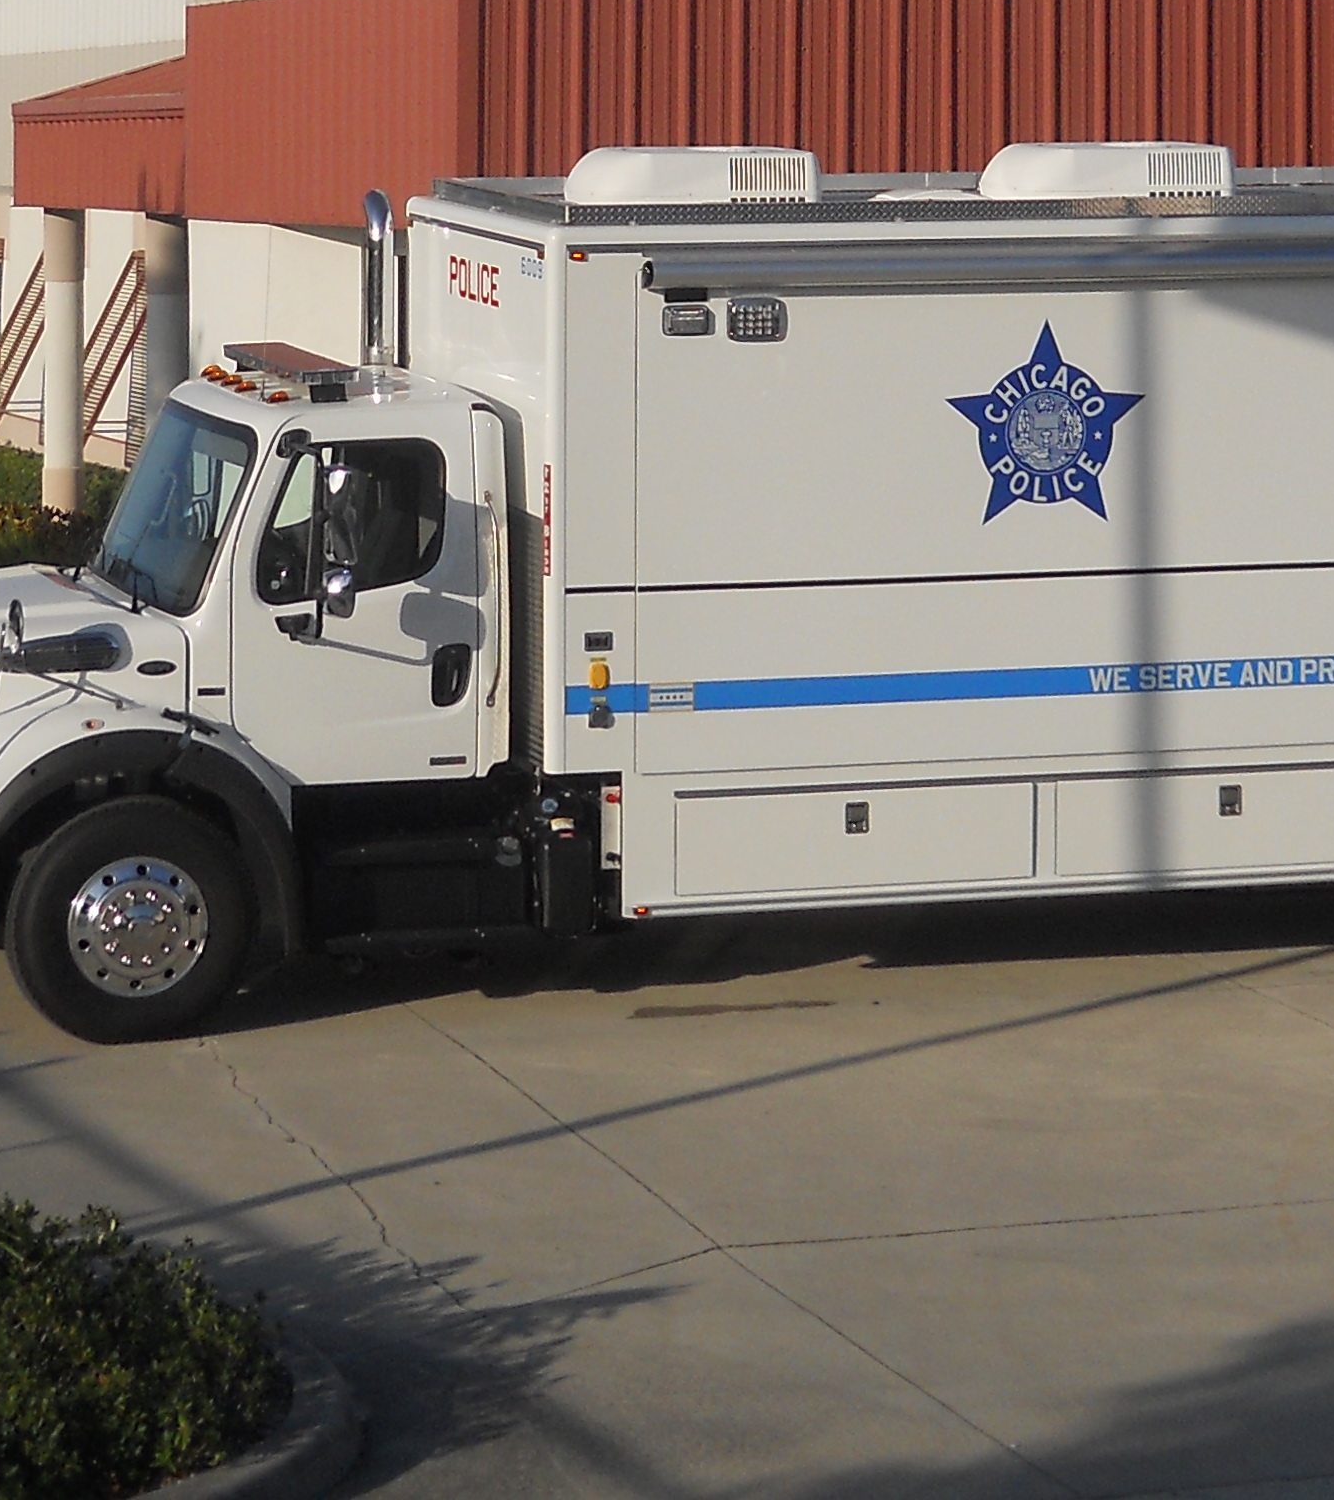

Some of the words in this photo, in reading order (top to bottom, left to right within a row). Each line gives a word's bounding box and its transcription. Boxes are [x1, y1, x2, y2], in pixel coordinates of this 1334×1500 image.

[449, 254, 500, 308] POLICE
[984, 363, 1106, 424] CHICAGO
[989, 451, 1103, 502] POLICE
[1089, 666, 1131, 693] WE
[1139, 662, 1233, 691] SERVE
[1239, 659, 1294, 687] AND
